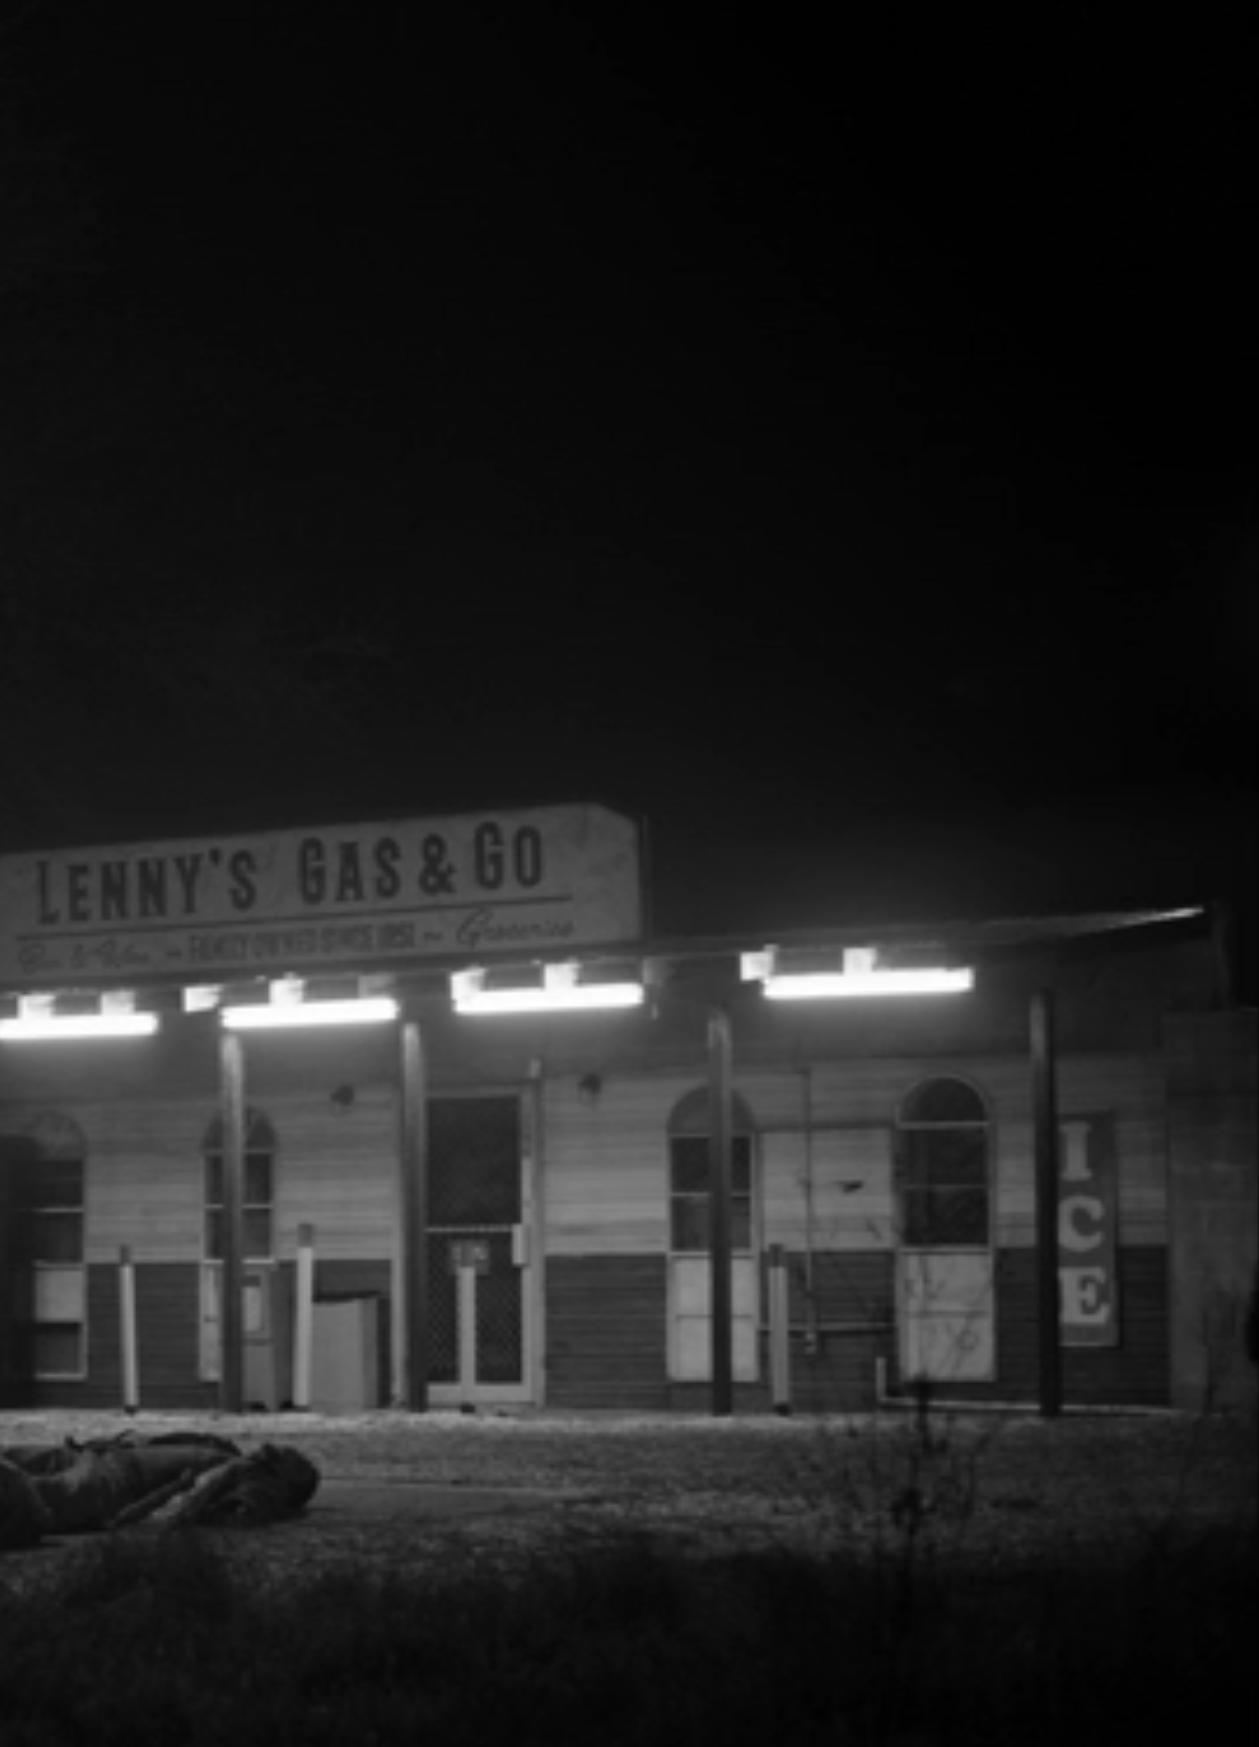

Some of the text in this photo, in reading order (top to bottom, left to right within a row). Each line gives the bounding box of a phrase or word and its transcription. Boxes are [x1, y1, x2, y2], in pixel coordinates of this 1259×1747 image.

[36, 820, 544, 925] LENNY'S GAS & GO
[1058, 1120, 1111, 1325] ICE
